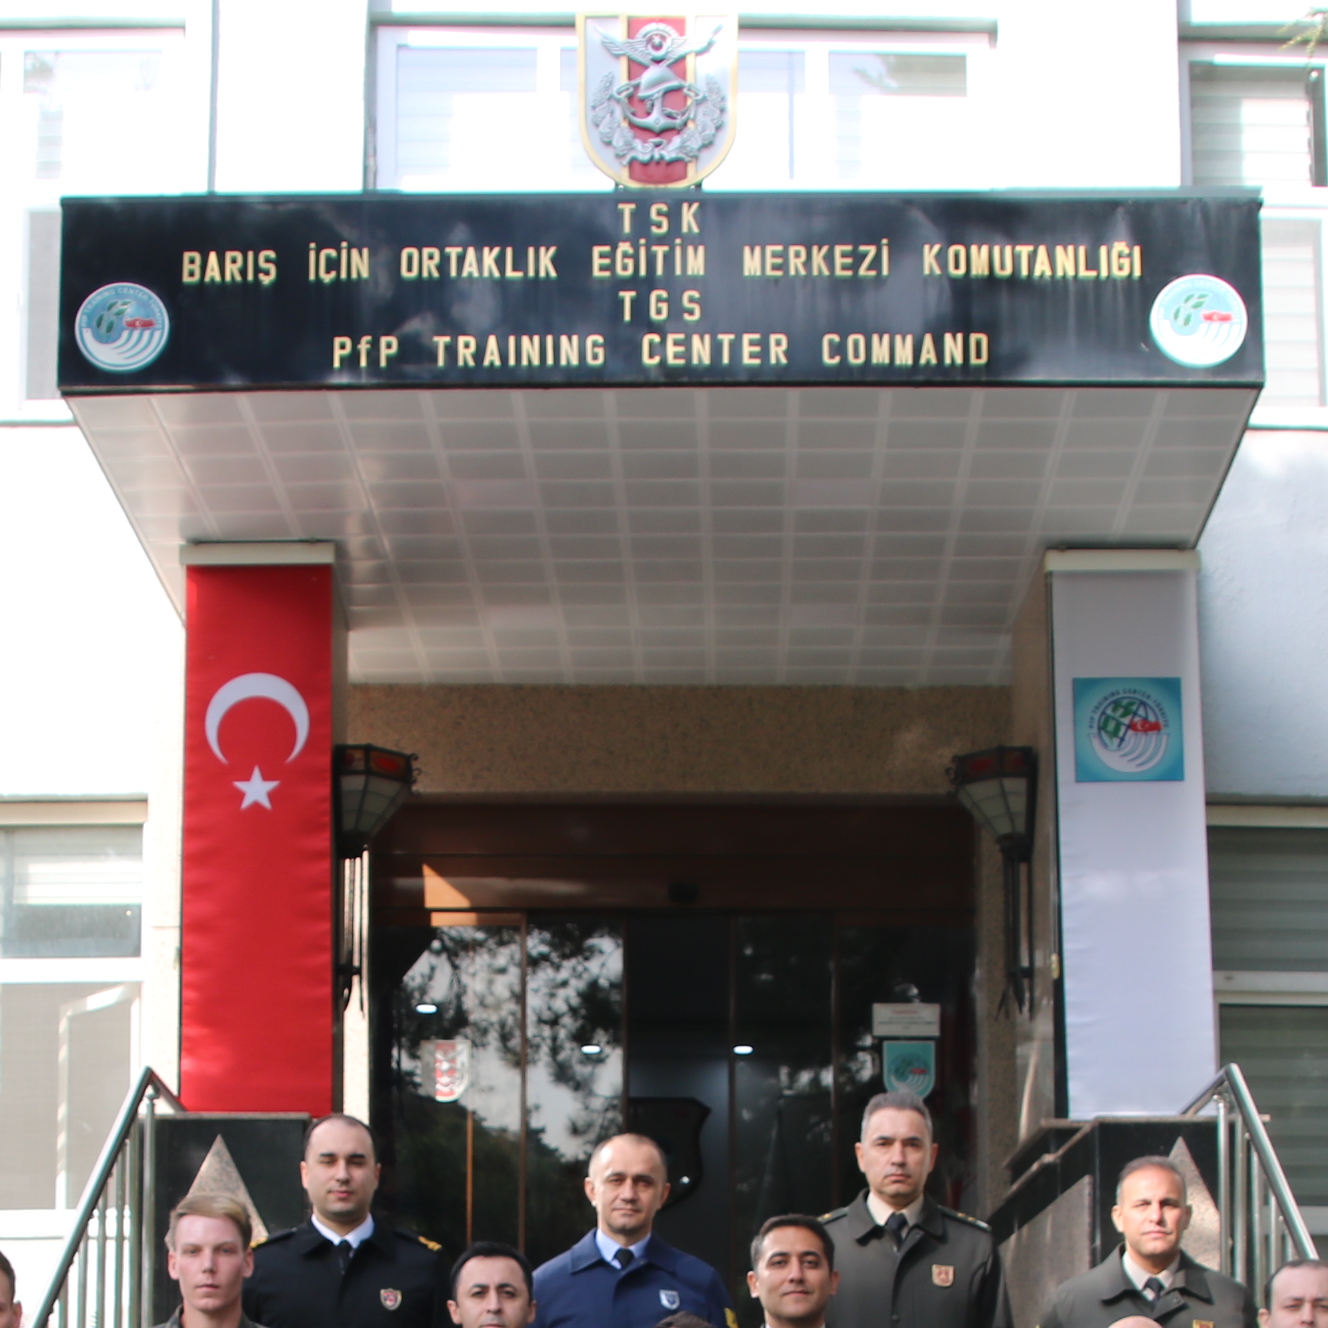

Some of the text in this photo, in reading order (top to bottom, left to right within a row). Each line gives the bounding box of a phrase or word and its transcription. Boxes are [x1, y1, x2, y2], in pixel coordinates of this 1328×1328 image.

[617, 201, 701, 234] TSK
[182, 238, 1142, 285] BARIŞ İÇİN ORTAKLIK EĞİTİM MERKEZİ KOMUTANLIĞI
[618, 289, 702, 322] TGS
[332, 332, 989, 368] PfP TRAINING CENTER COMMAND
